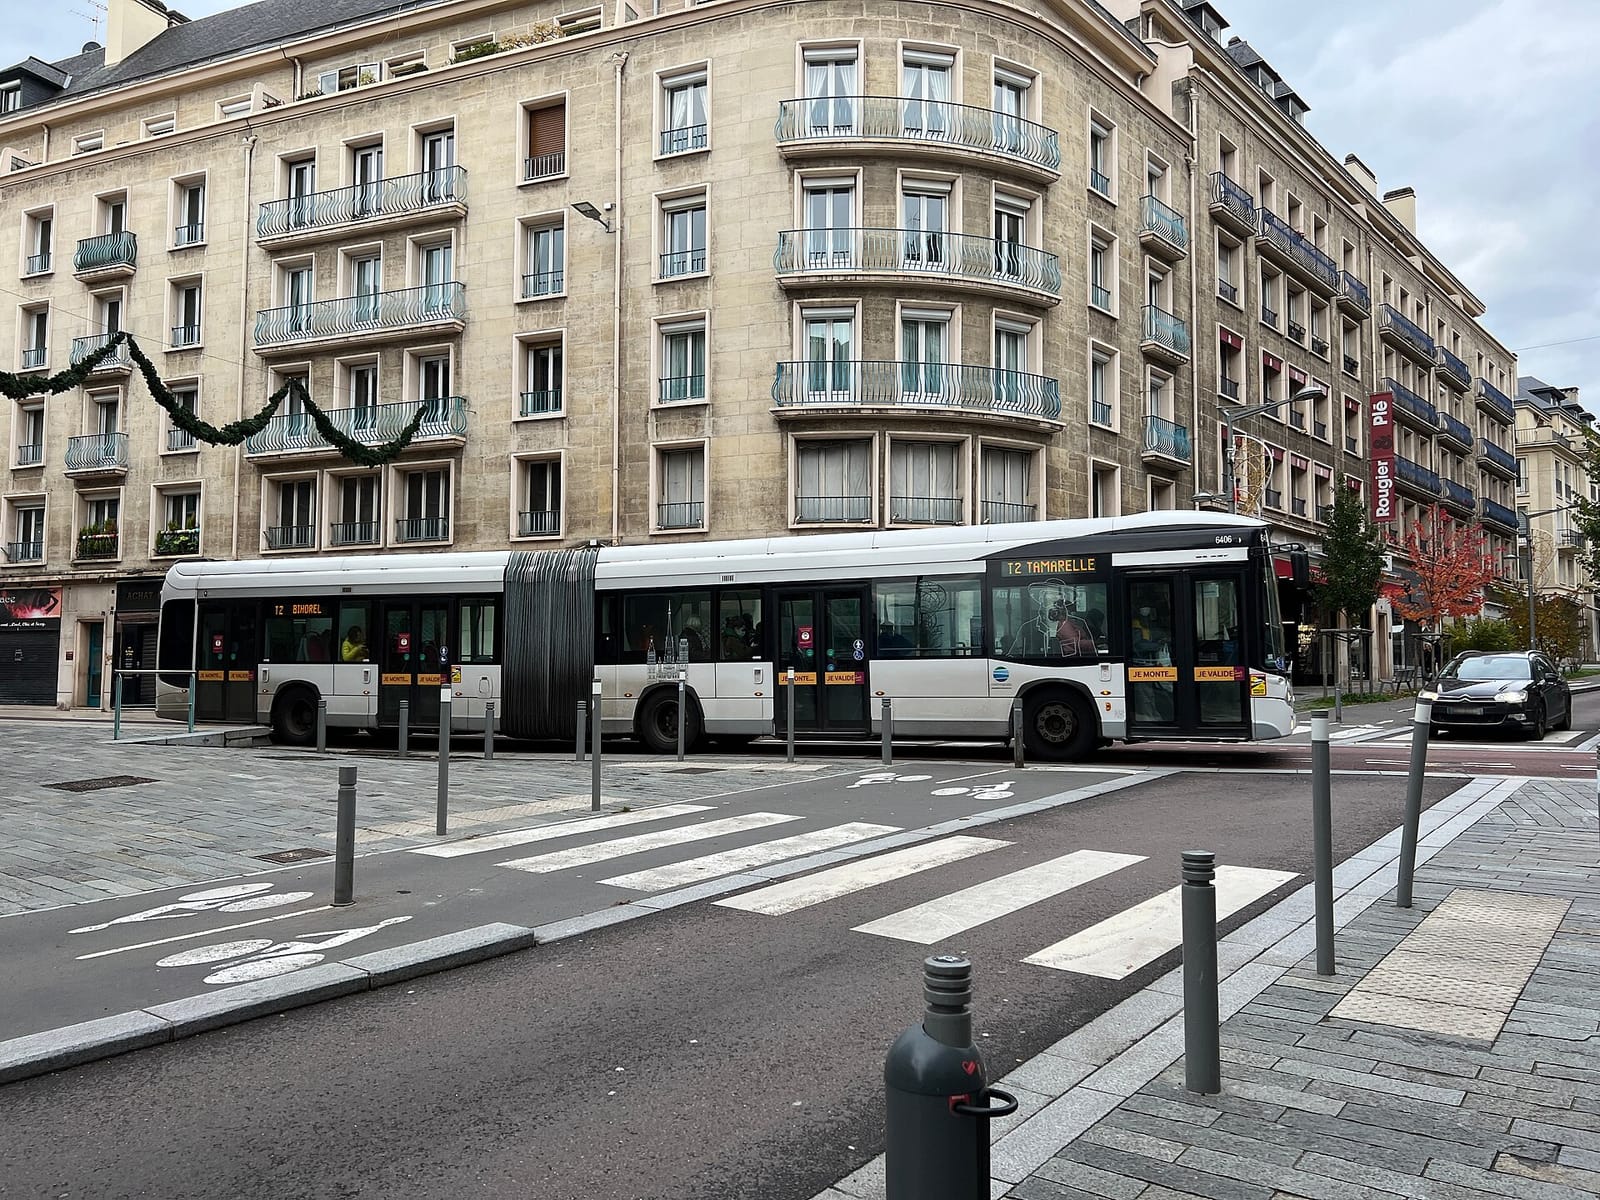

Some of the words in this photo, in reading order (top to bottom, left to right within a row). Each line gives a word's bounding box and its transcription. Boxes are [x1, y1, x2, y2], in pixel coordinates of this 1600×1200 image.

[1373, 435, 1392, 449] &
[1375, 460, 1393, 517] Rougier
[1215, 535, 1233, 545] 6406
[1007, 562, 1022, 575] T2
[1026, 558, 1096, 574] TAMARELLE
[127, 591, 154, 600] ACHAT
[292, 603, 322, 614] BIHOREL
[1132, 670, 1142, 678] JE
[1197, 670, 1207, 678] JE
[1208, 670, 1235, 678] VALIDE
